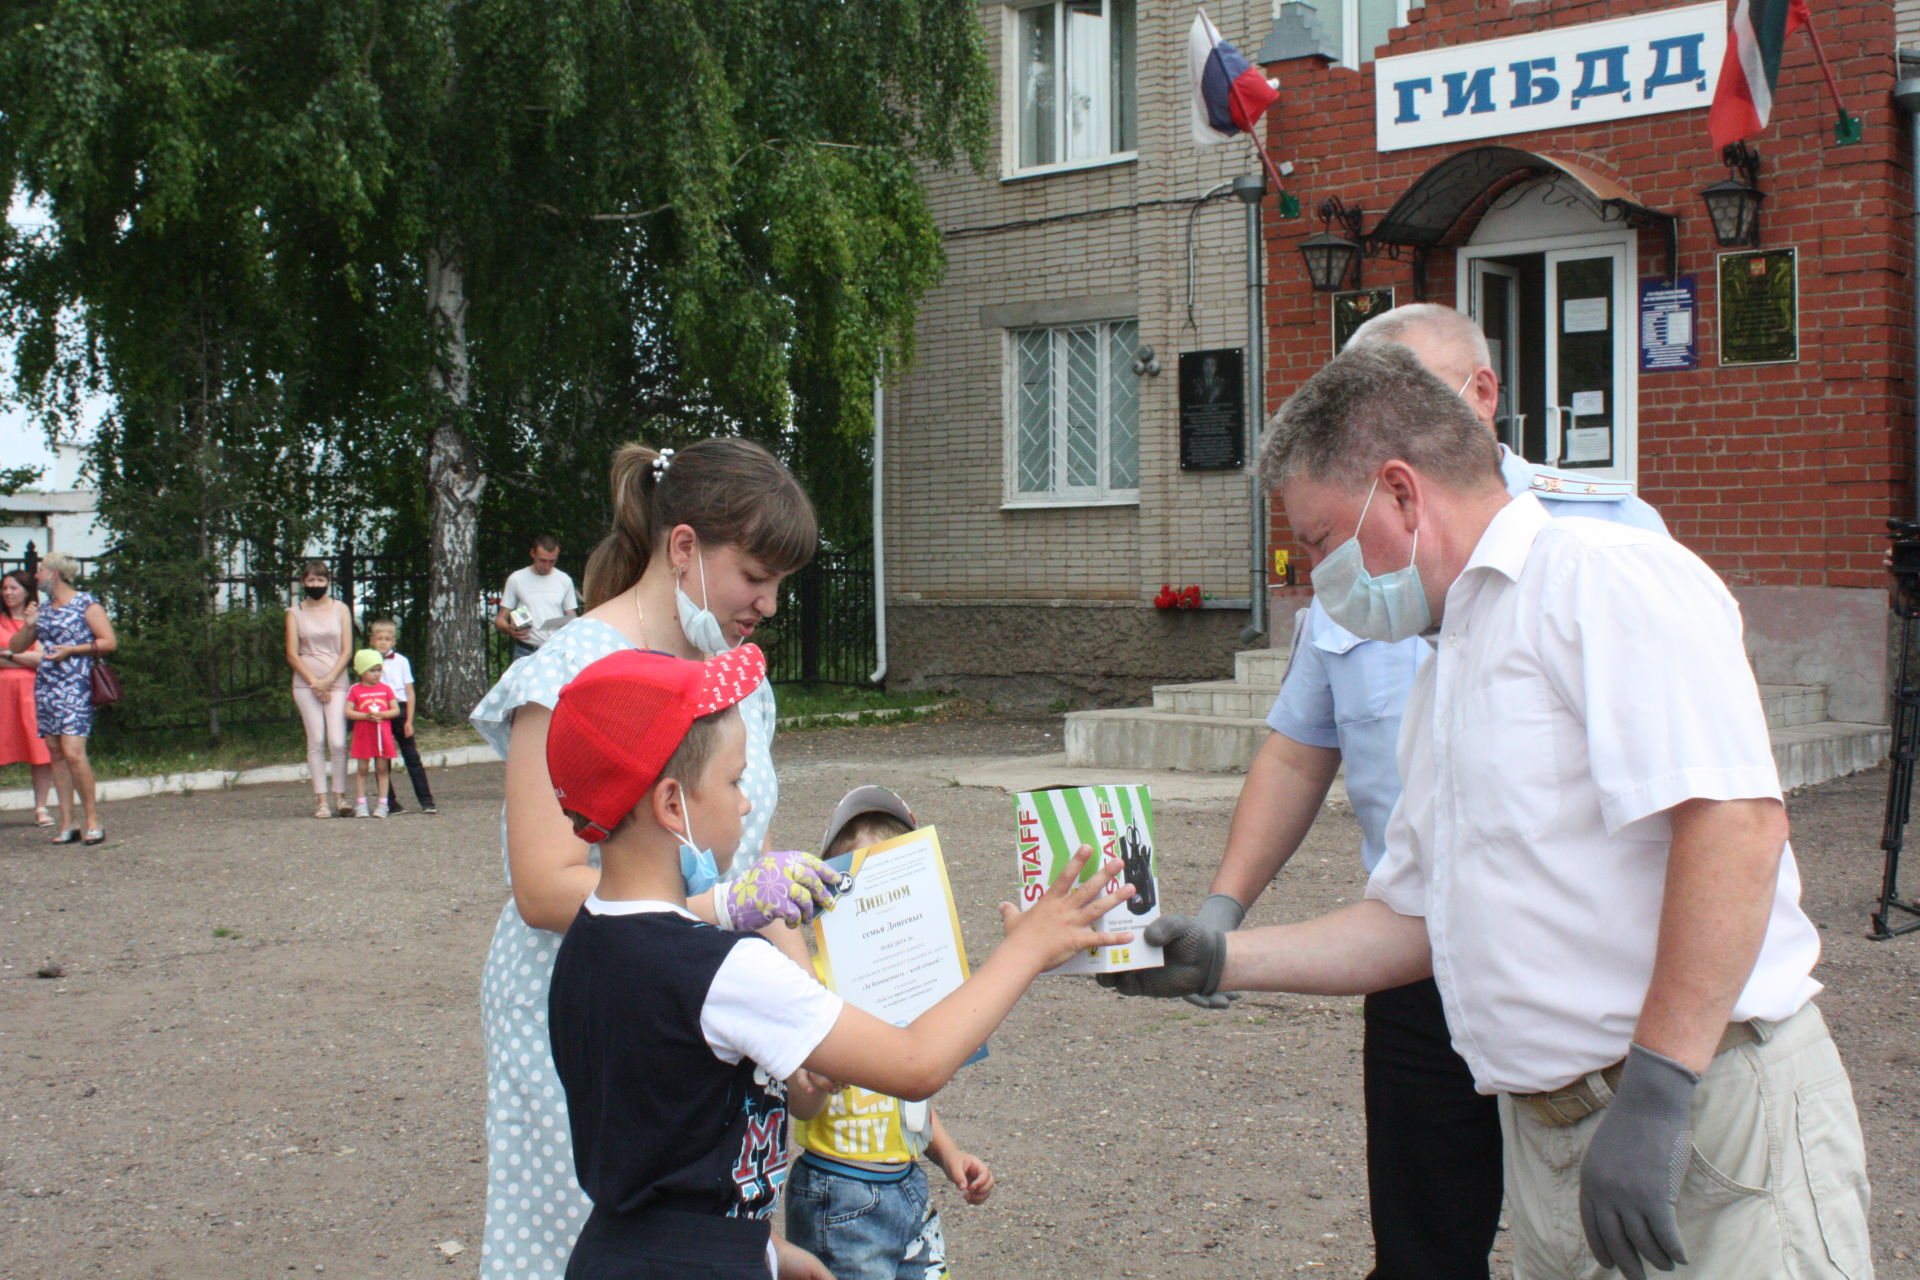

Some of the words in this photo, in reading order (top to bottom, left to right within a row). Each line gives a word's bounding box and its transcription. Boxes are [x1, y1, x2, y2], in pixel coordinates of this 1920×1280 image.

[1393, 32, 1706, 125] ГИБДД
[1018, 810, 1045, 902] STAFF
[1099, 802, 1119, 895] SAFF
[855, 884, 911, 916] Диплом
[834, 1117, 890, 1153] CITY
